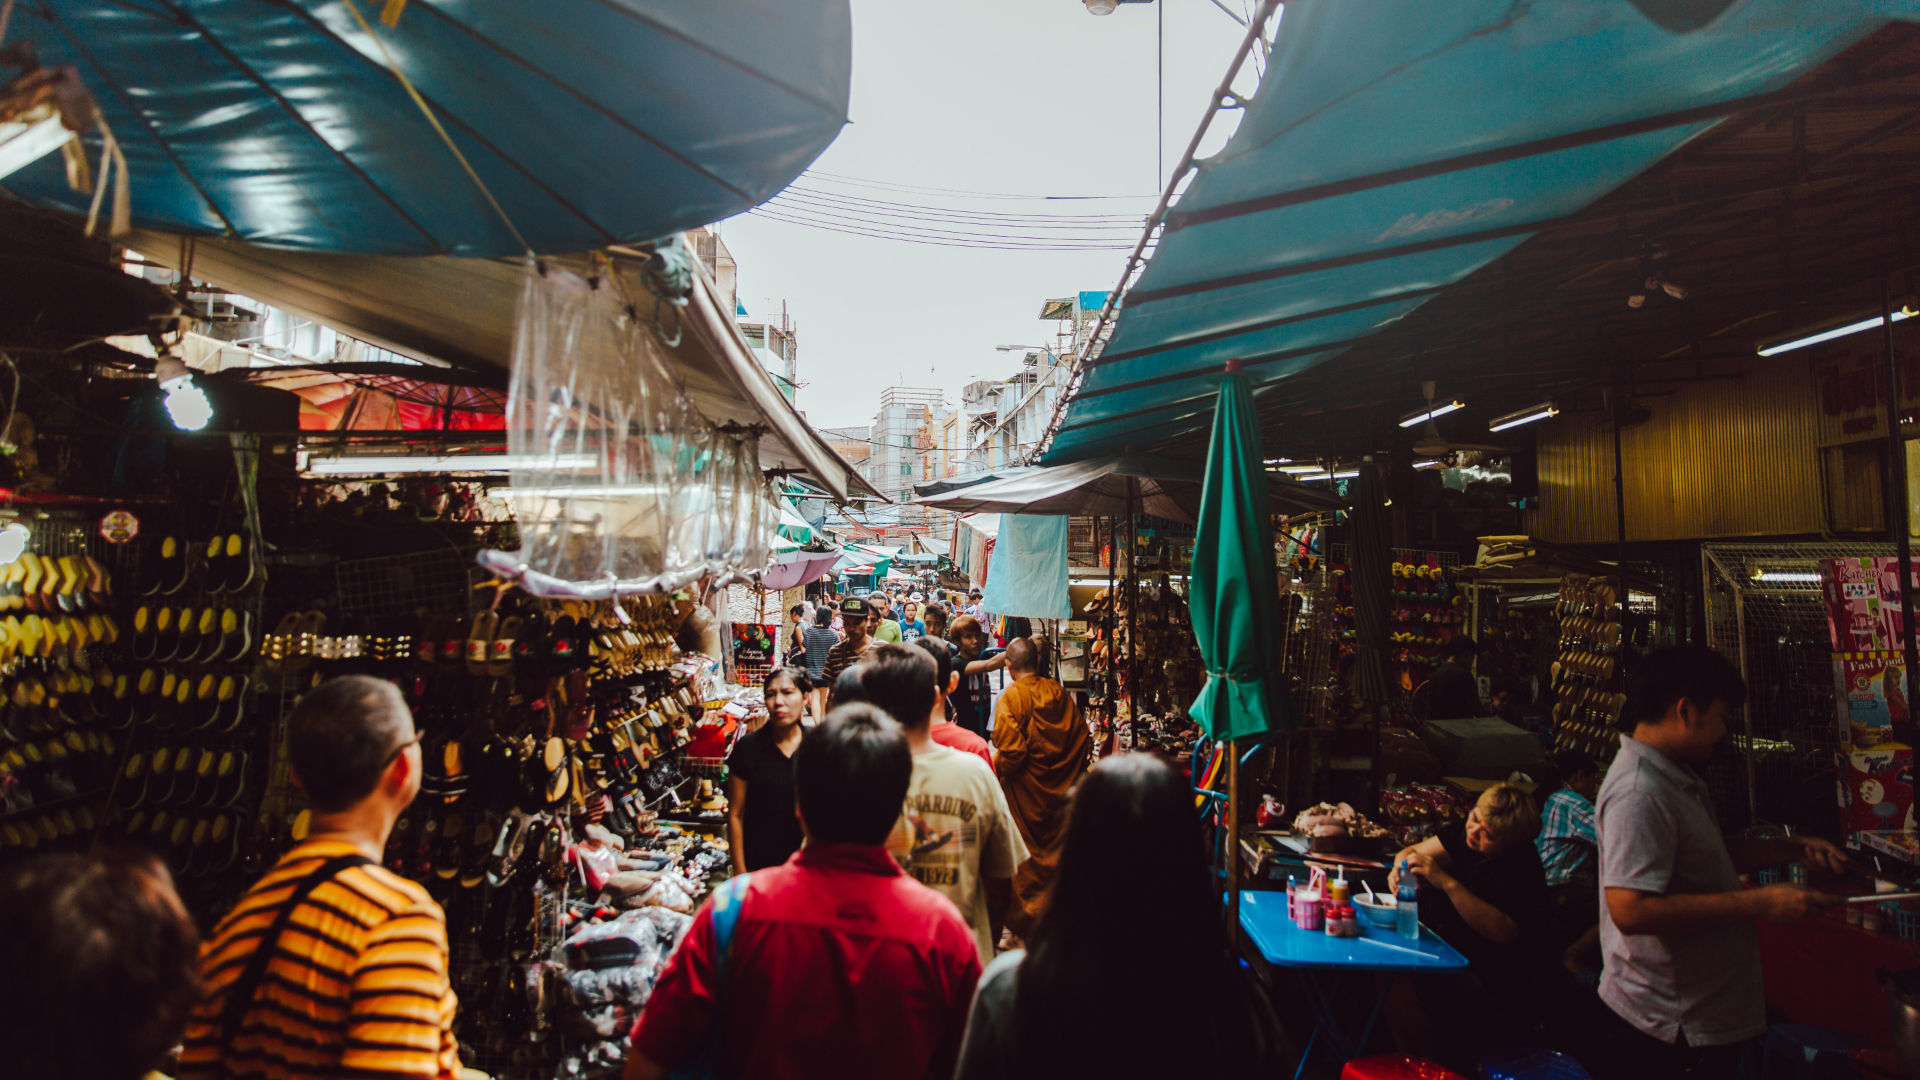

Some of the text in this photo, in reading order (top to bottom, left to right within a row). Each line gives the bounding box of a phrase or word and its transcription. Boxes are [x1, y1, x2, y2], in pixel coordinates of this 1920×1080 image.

[1849, 654, 1905, 672] Fast Food
[923, 867, 954, 885] 1972
